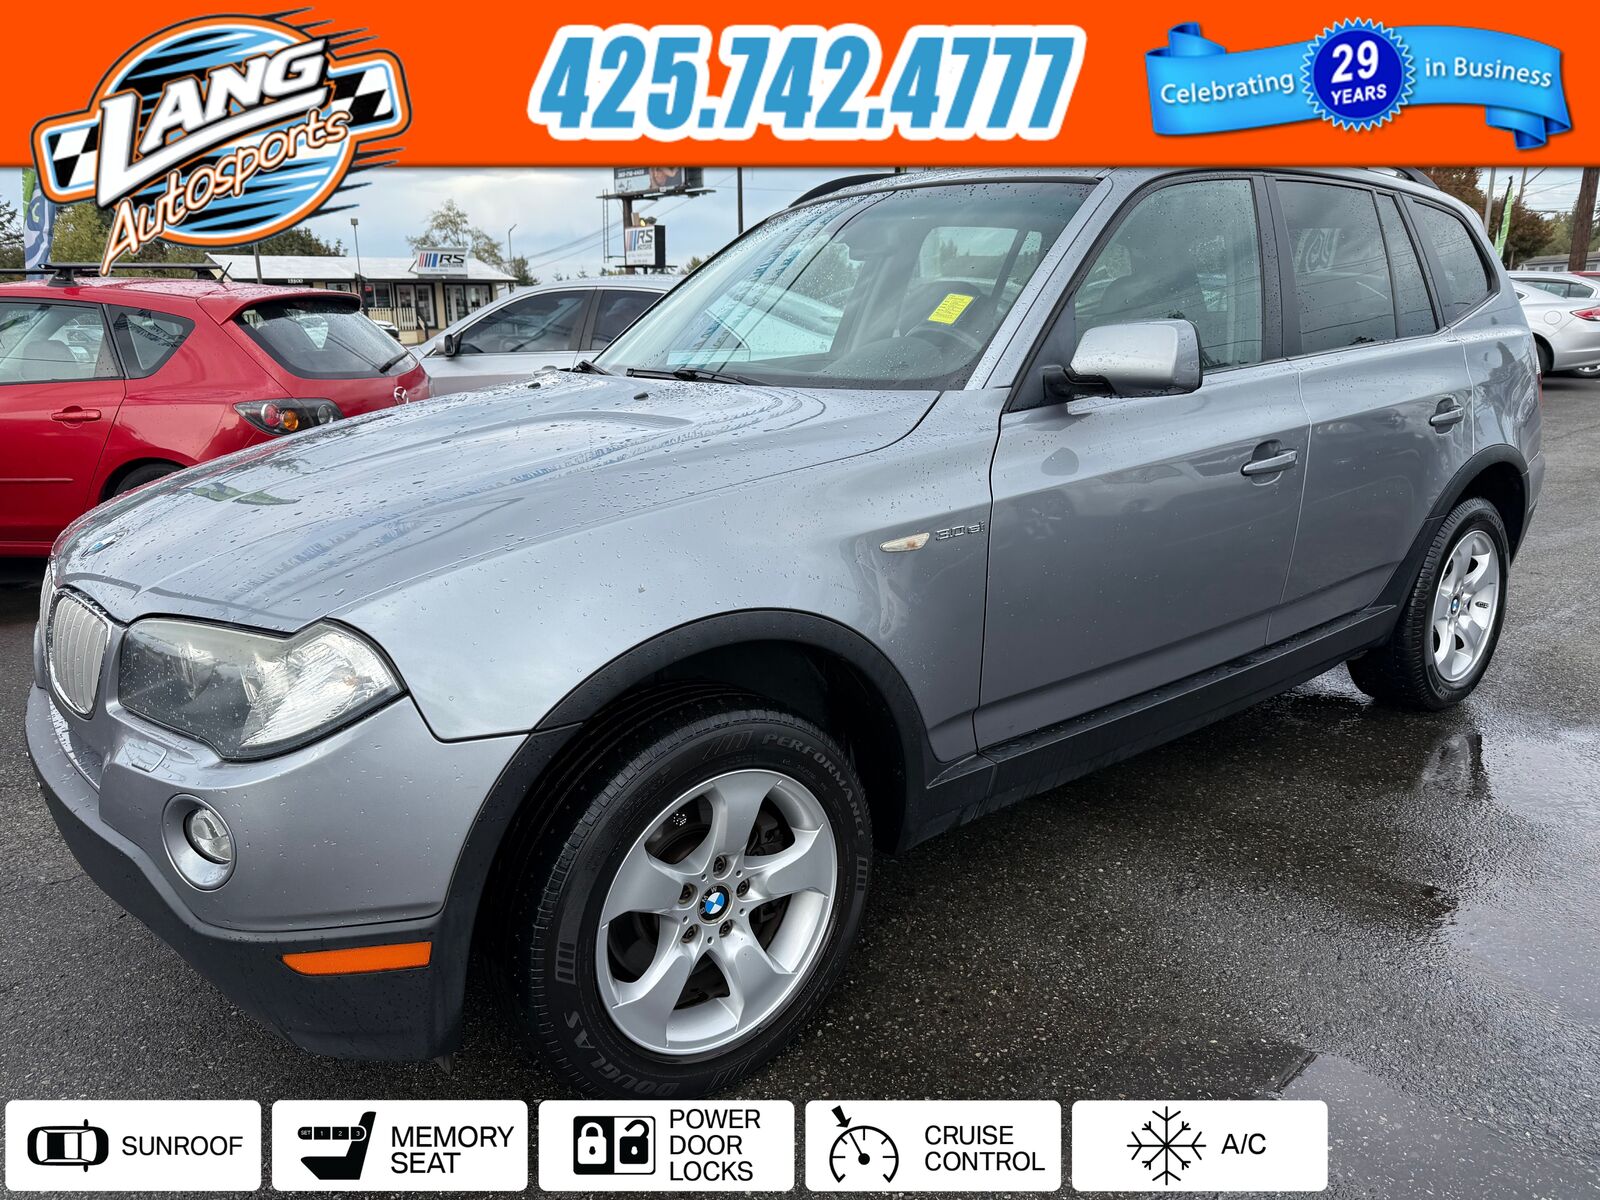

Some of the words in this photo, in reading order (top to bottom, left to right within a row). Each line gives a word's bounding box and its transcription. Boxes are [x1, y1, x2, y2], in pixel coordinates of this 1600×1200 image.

[439, 253, 466, 264] RS
[637, 229, 654, 244] RS
[761, 733, 866, 838] PERFORMANCE
[563, 1010, 681, 1097] DOUGLAS
